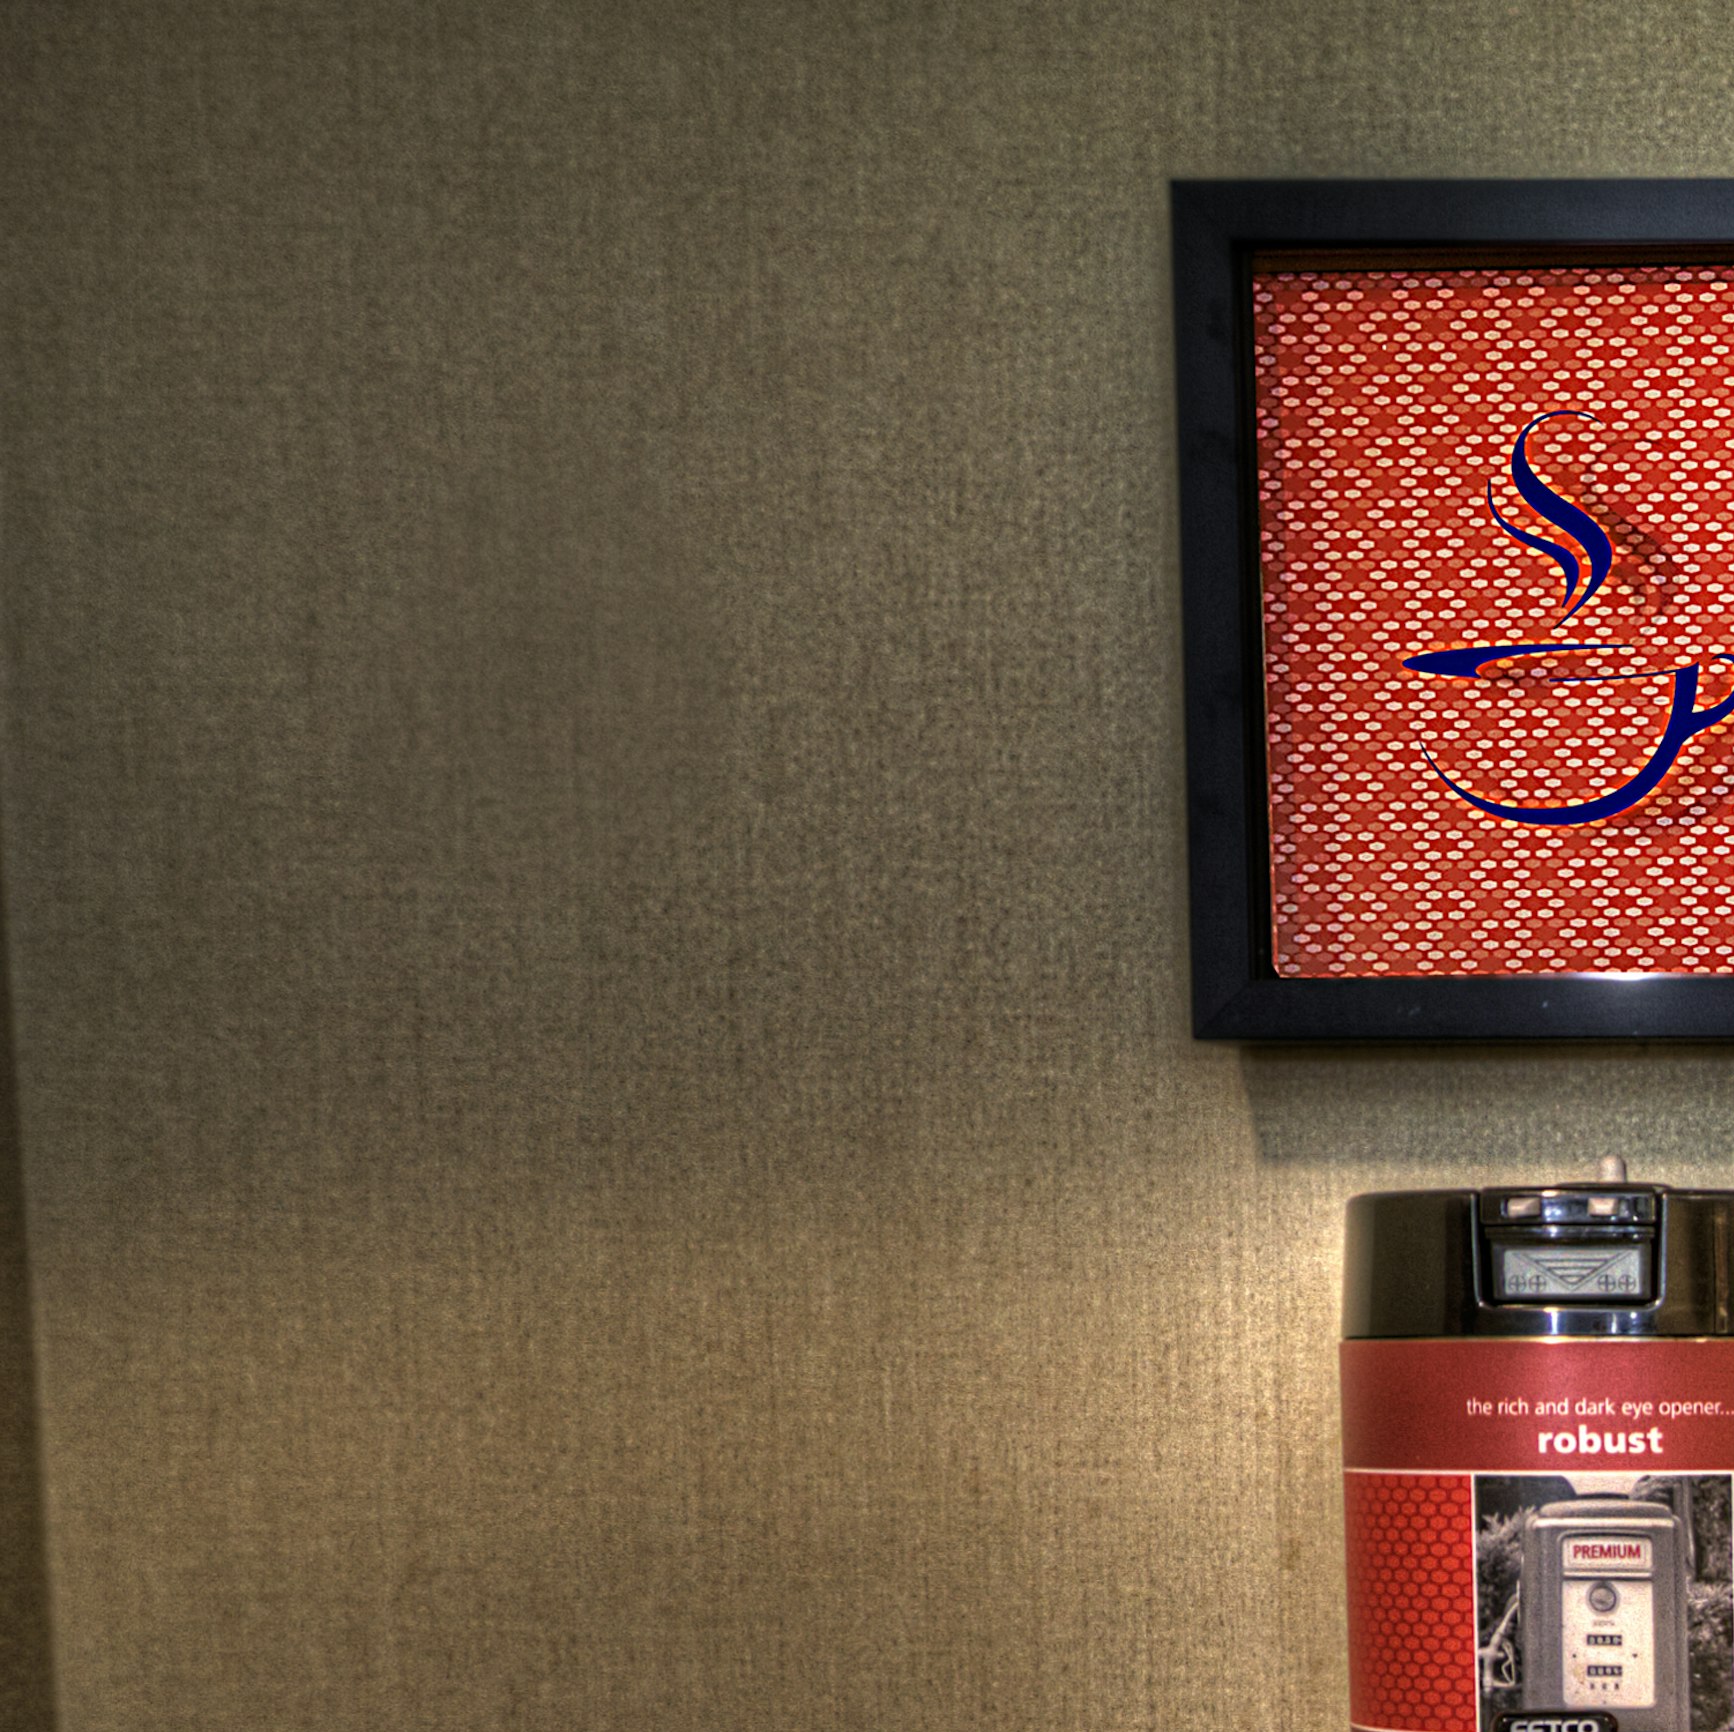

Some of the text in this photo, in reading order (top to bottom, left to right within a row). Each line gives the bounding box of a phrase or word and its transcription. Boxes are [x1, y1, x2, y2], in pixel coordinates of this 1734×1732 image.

[1467, 1397, 1734, 1419] the rich and dark eye opener...
[1538, 1424, 1663, 1453] robust
[1573, 1545, 1641, 1559] PREMIUM
